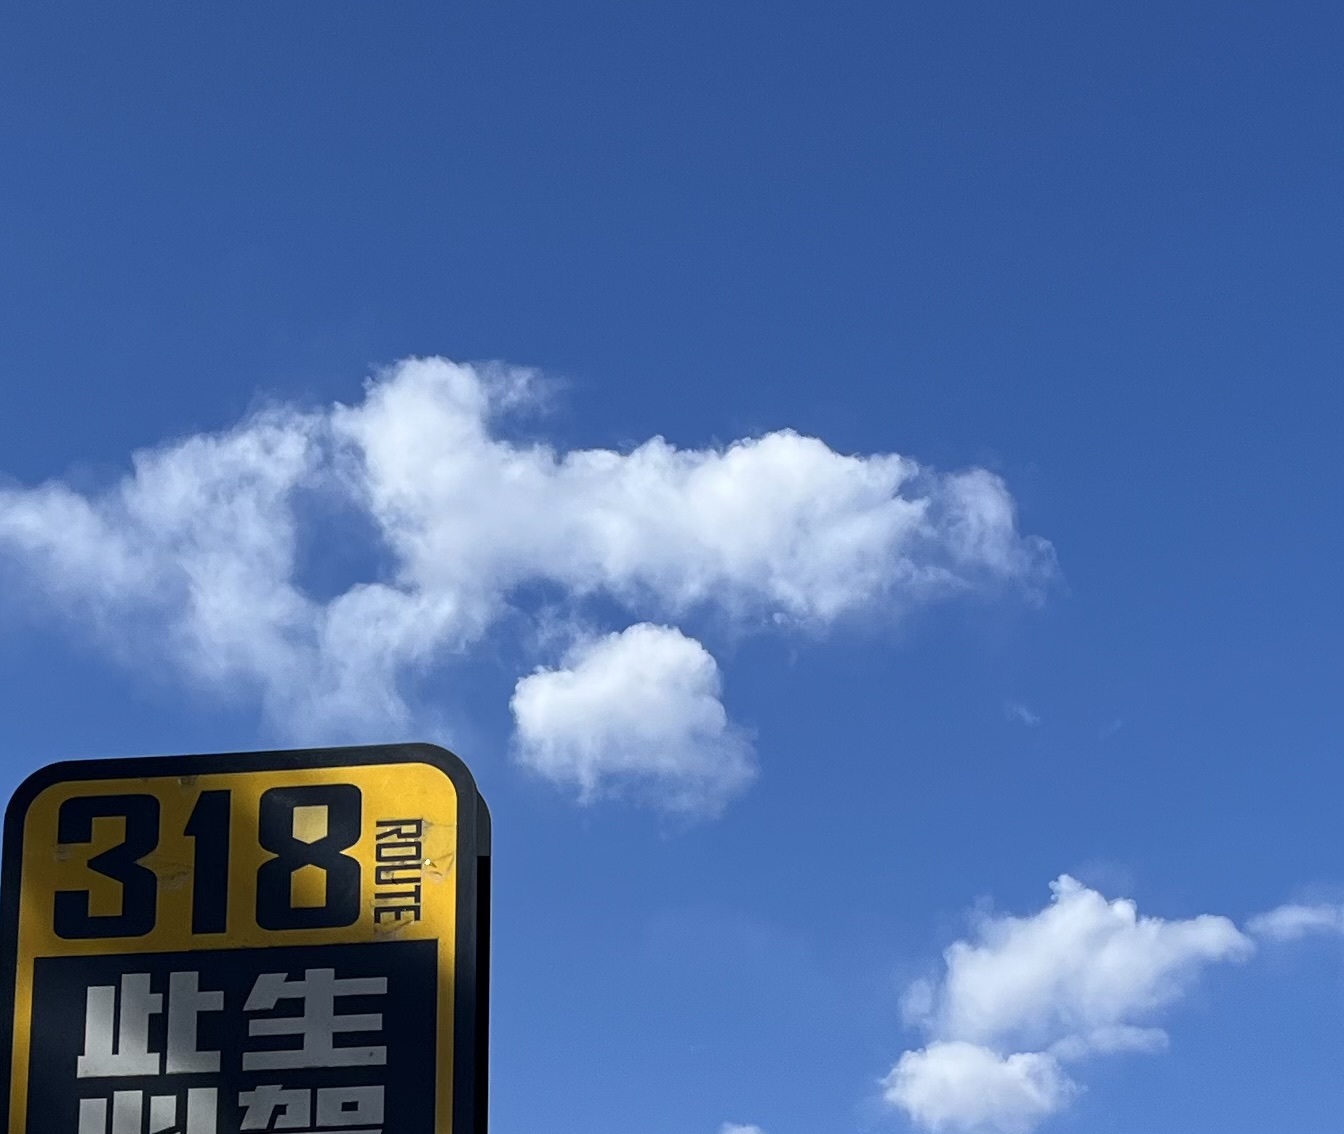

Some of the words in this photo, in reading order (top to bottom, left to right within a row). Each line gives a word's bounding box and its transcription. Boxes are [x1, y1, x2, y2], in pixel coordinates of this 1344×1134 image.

[53, 783, 363, 939] 318
[374, 818, 423, 924] ROUTE
[76, 968, 388, 1078] 此生
